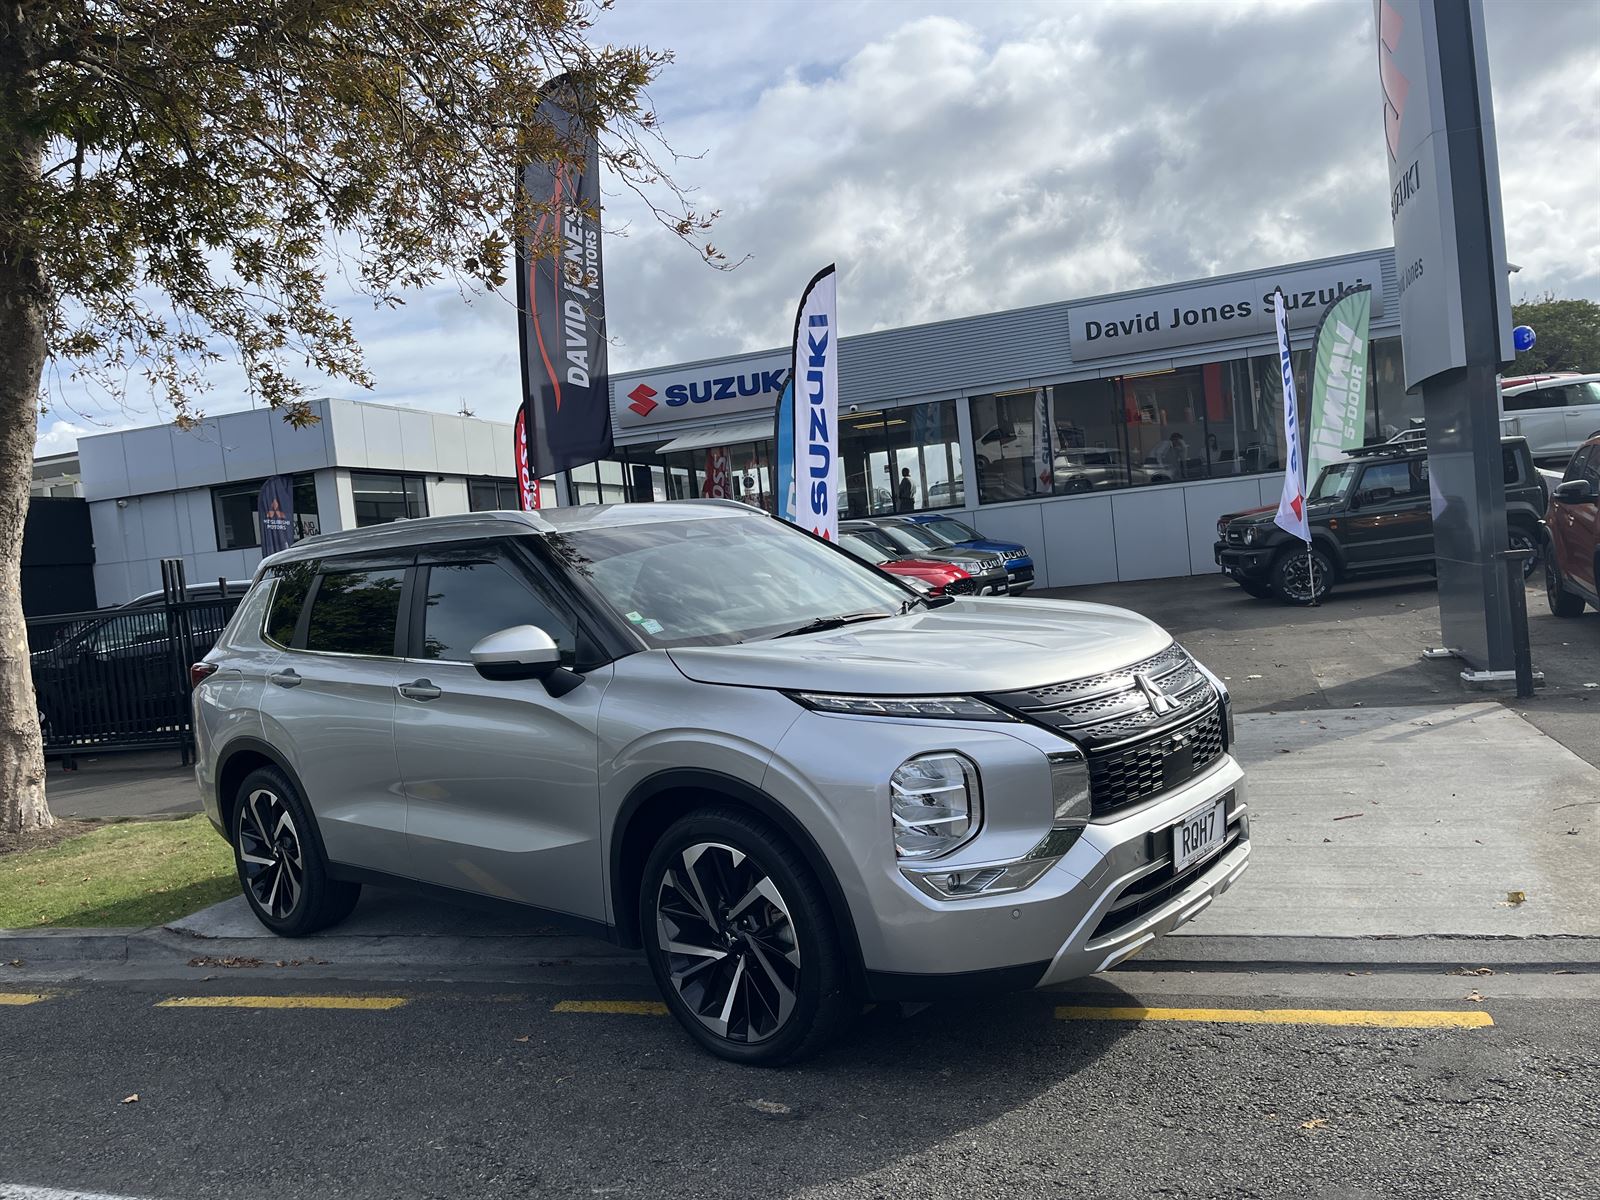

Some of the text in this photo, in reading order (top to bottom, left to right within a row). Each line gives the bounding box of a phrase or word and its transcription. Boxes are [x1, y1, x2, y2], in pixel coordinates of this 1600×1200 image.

[564, 300, 590, 388] DAVID
[1085, 312, 1161, 341] David
[1170, 301, 1252, 328] Jones
[665, 368, 793, 408] SUZUK
[806, 314, 831, 517] SUZUKI
[1343, 365, 1363, 440] 5-DOOR
[1182, 811, 1215, 858] RQH7
